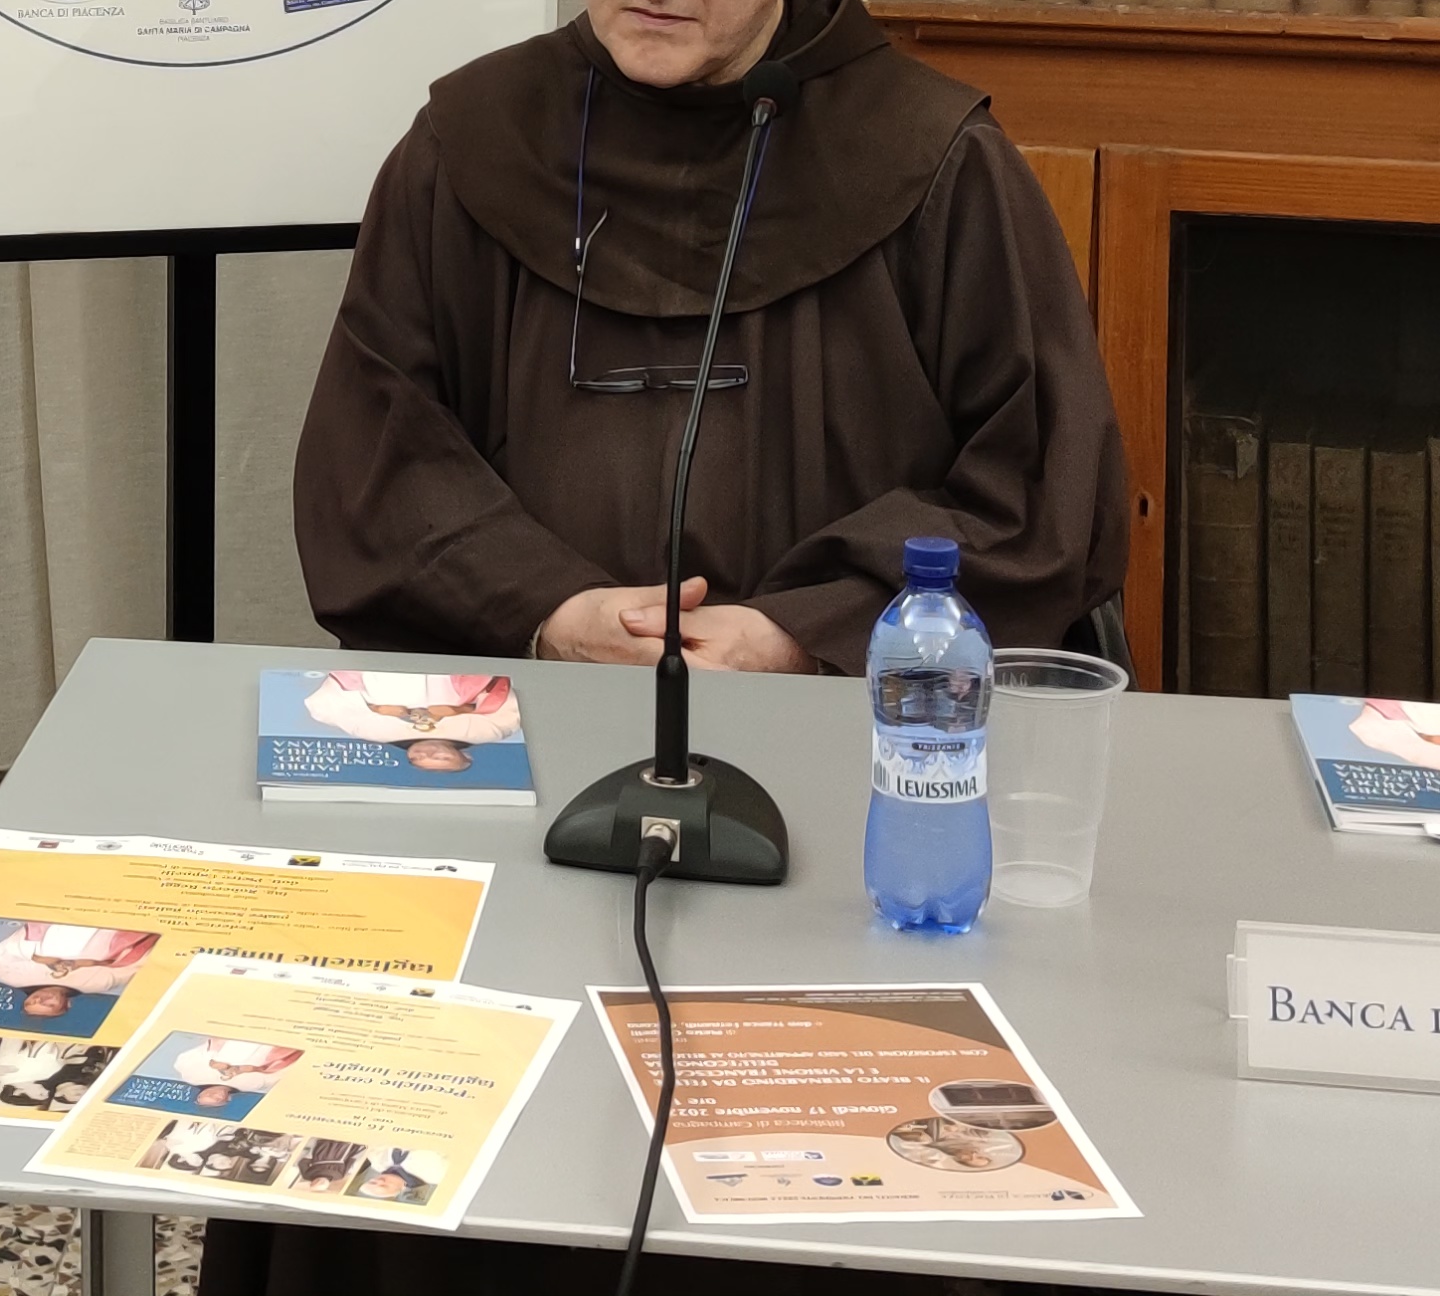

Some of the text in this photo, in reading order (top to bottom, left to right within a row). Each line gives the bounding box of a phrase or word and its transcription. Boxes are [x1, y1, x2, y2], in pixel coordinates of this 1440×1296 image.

[18, 7, 125, 18] BANCA DI PIACENZA
[897, 775, 977, 798] LEVISSIMA
[1268, 985, 1415, 1032] BANCA
[648, 1068, 767, 1077] FRANCESCAA
[772, 1068, 839, 1076] VISIONE
[711, 1078, 737, 1086] DA
[741, 1077, 853, 1086] BERNARDINO
[857, 1076, 911, 1085] BEATO
[715, 1106, 802, 1116] novembre
[809, 1106, 826, 1115] 17
[832, 1105, 898, 1115] Giovedì
